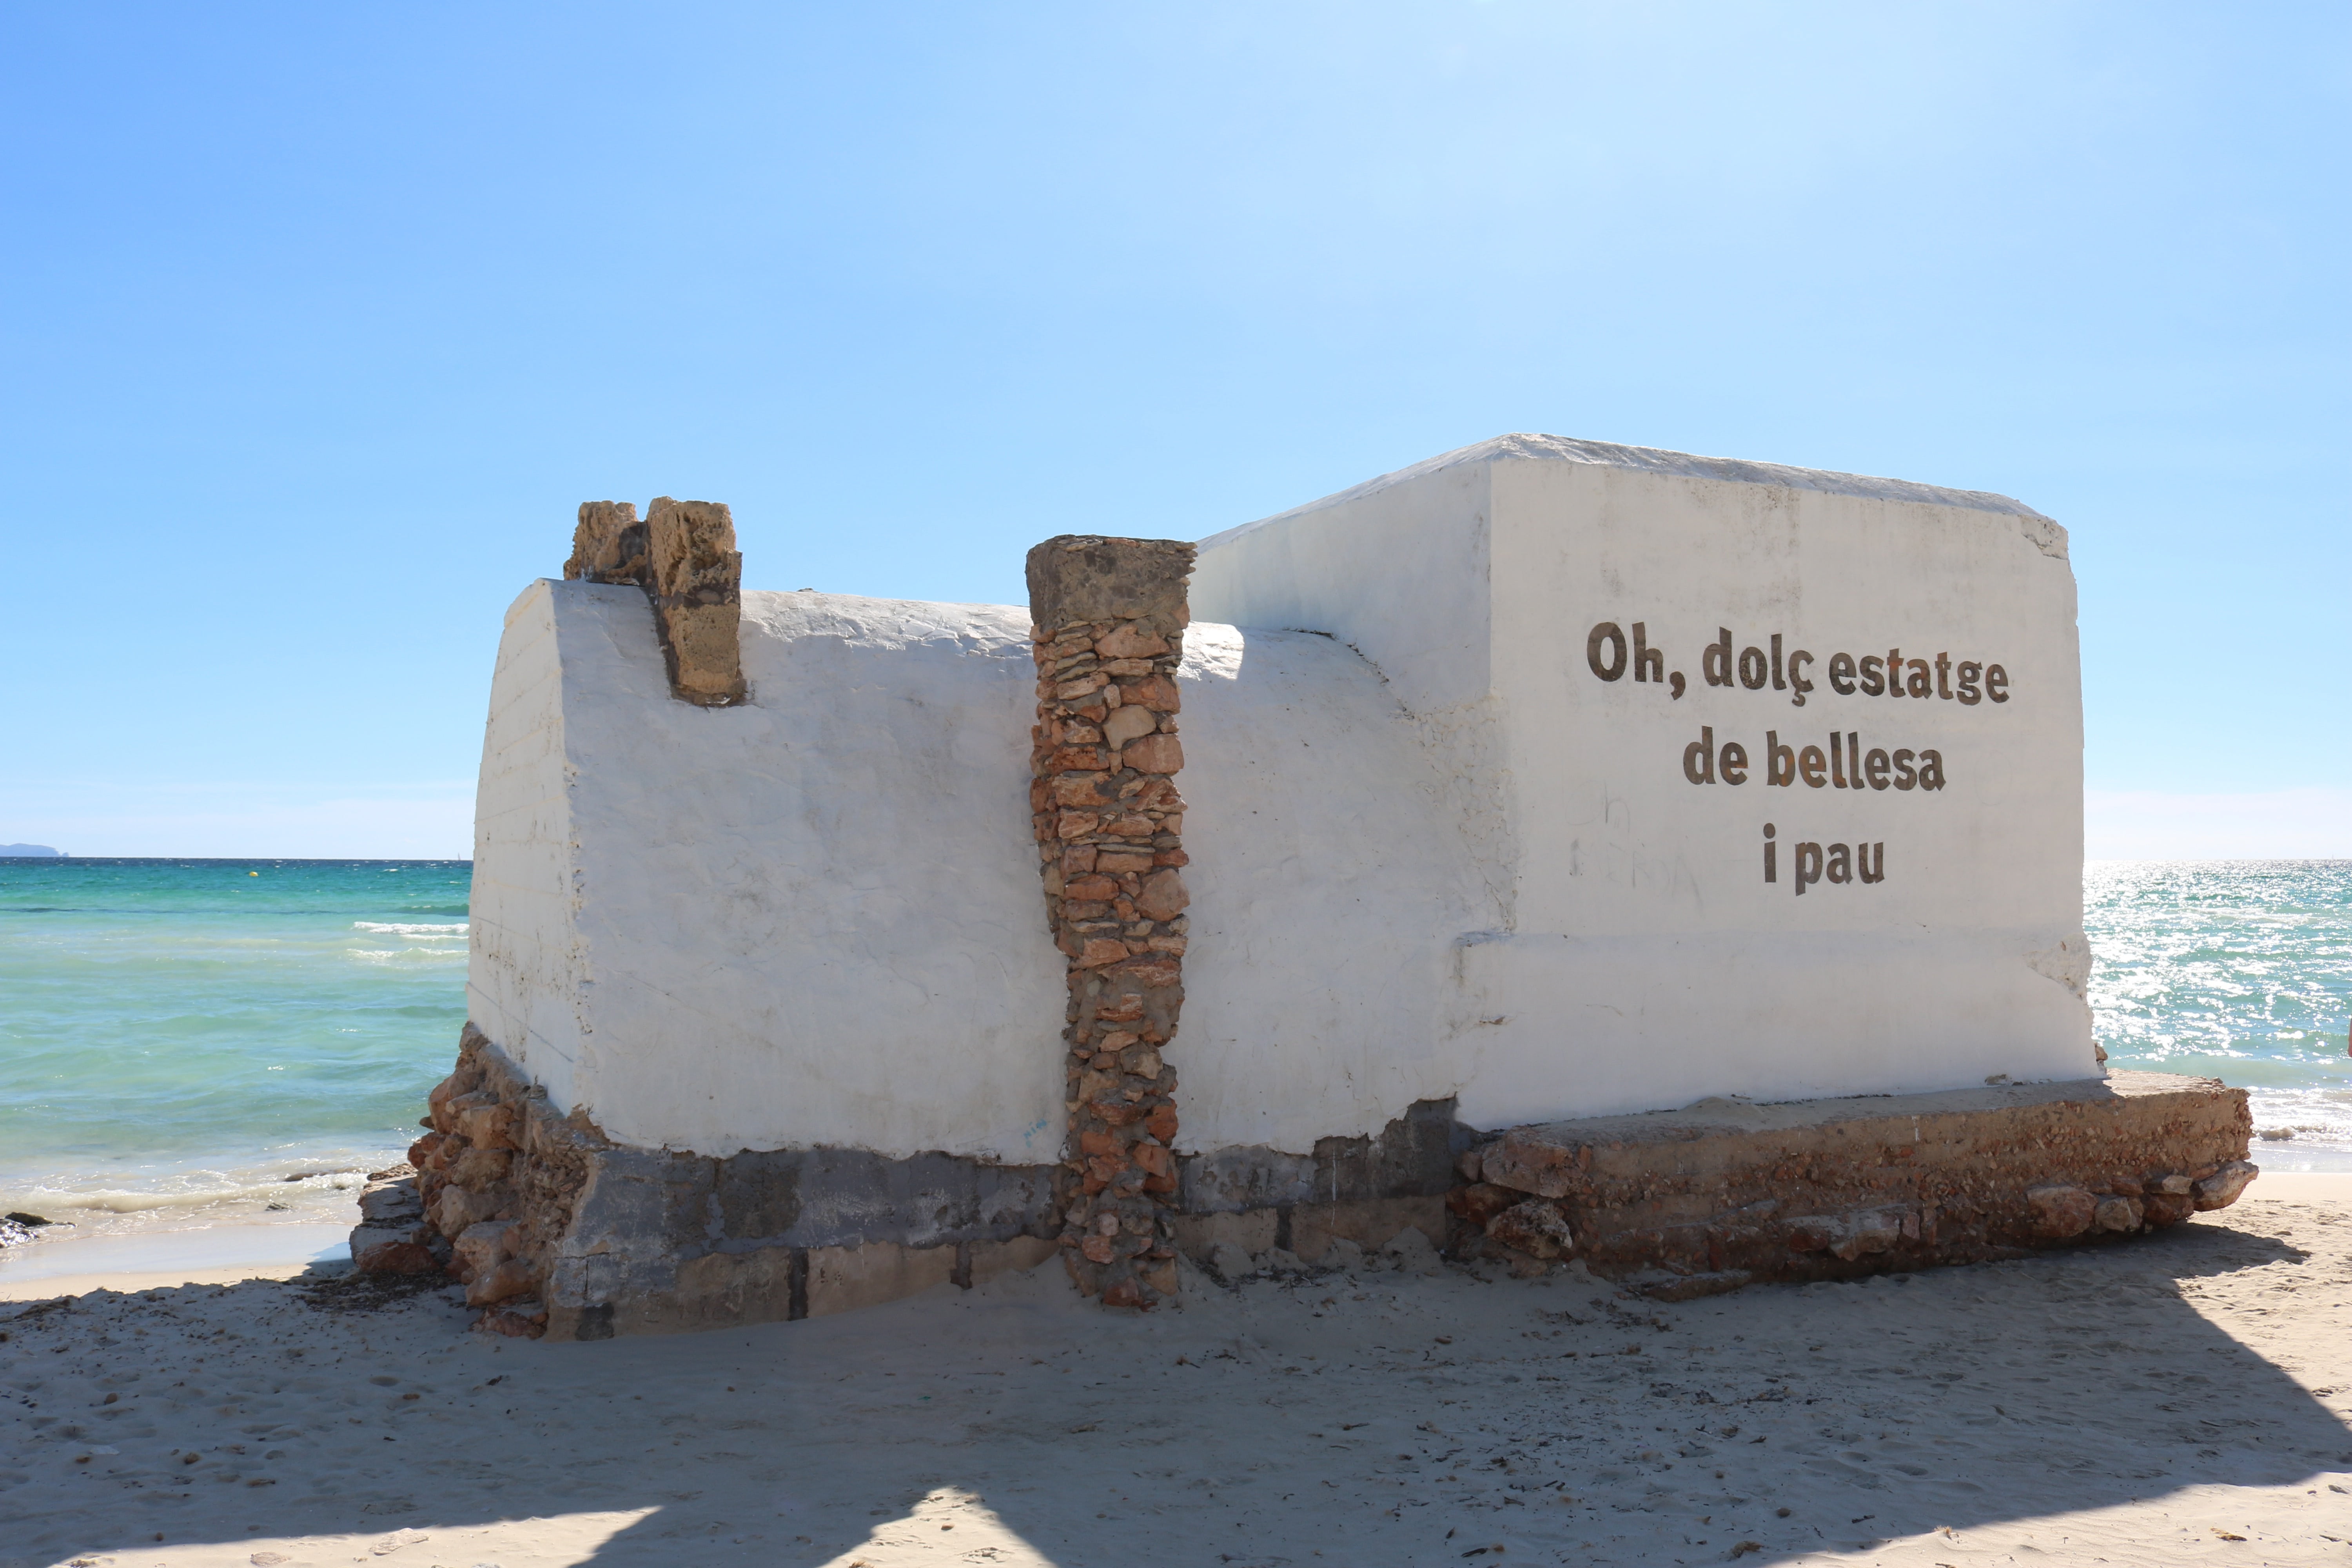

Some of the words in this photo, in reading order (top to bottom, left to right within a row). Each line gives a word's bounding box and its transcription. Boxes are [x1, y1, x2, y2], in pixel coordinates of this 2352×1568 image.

[1586, 621, 1686, 701] Oh,
[1702, 626, 1815, 708] dolç
[1828, 648, 2010, 706] estatge
[1682, 725, 1749, 786] de
[1765, 730, 1947, 792] bellesa
[1762, 822, 1777, 883] i
[1794, 841, 1886, 897] pau
